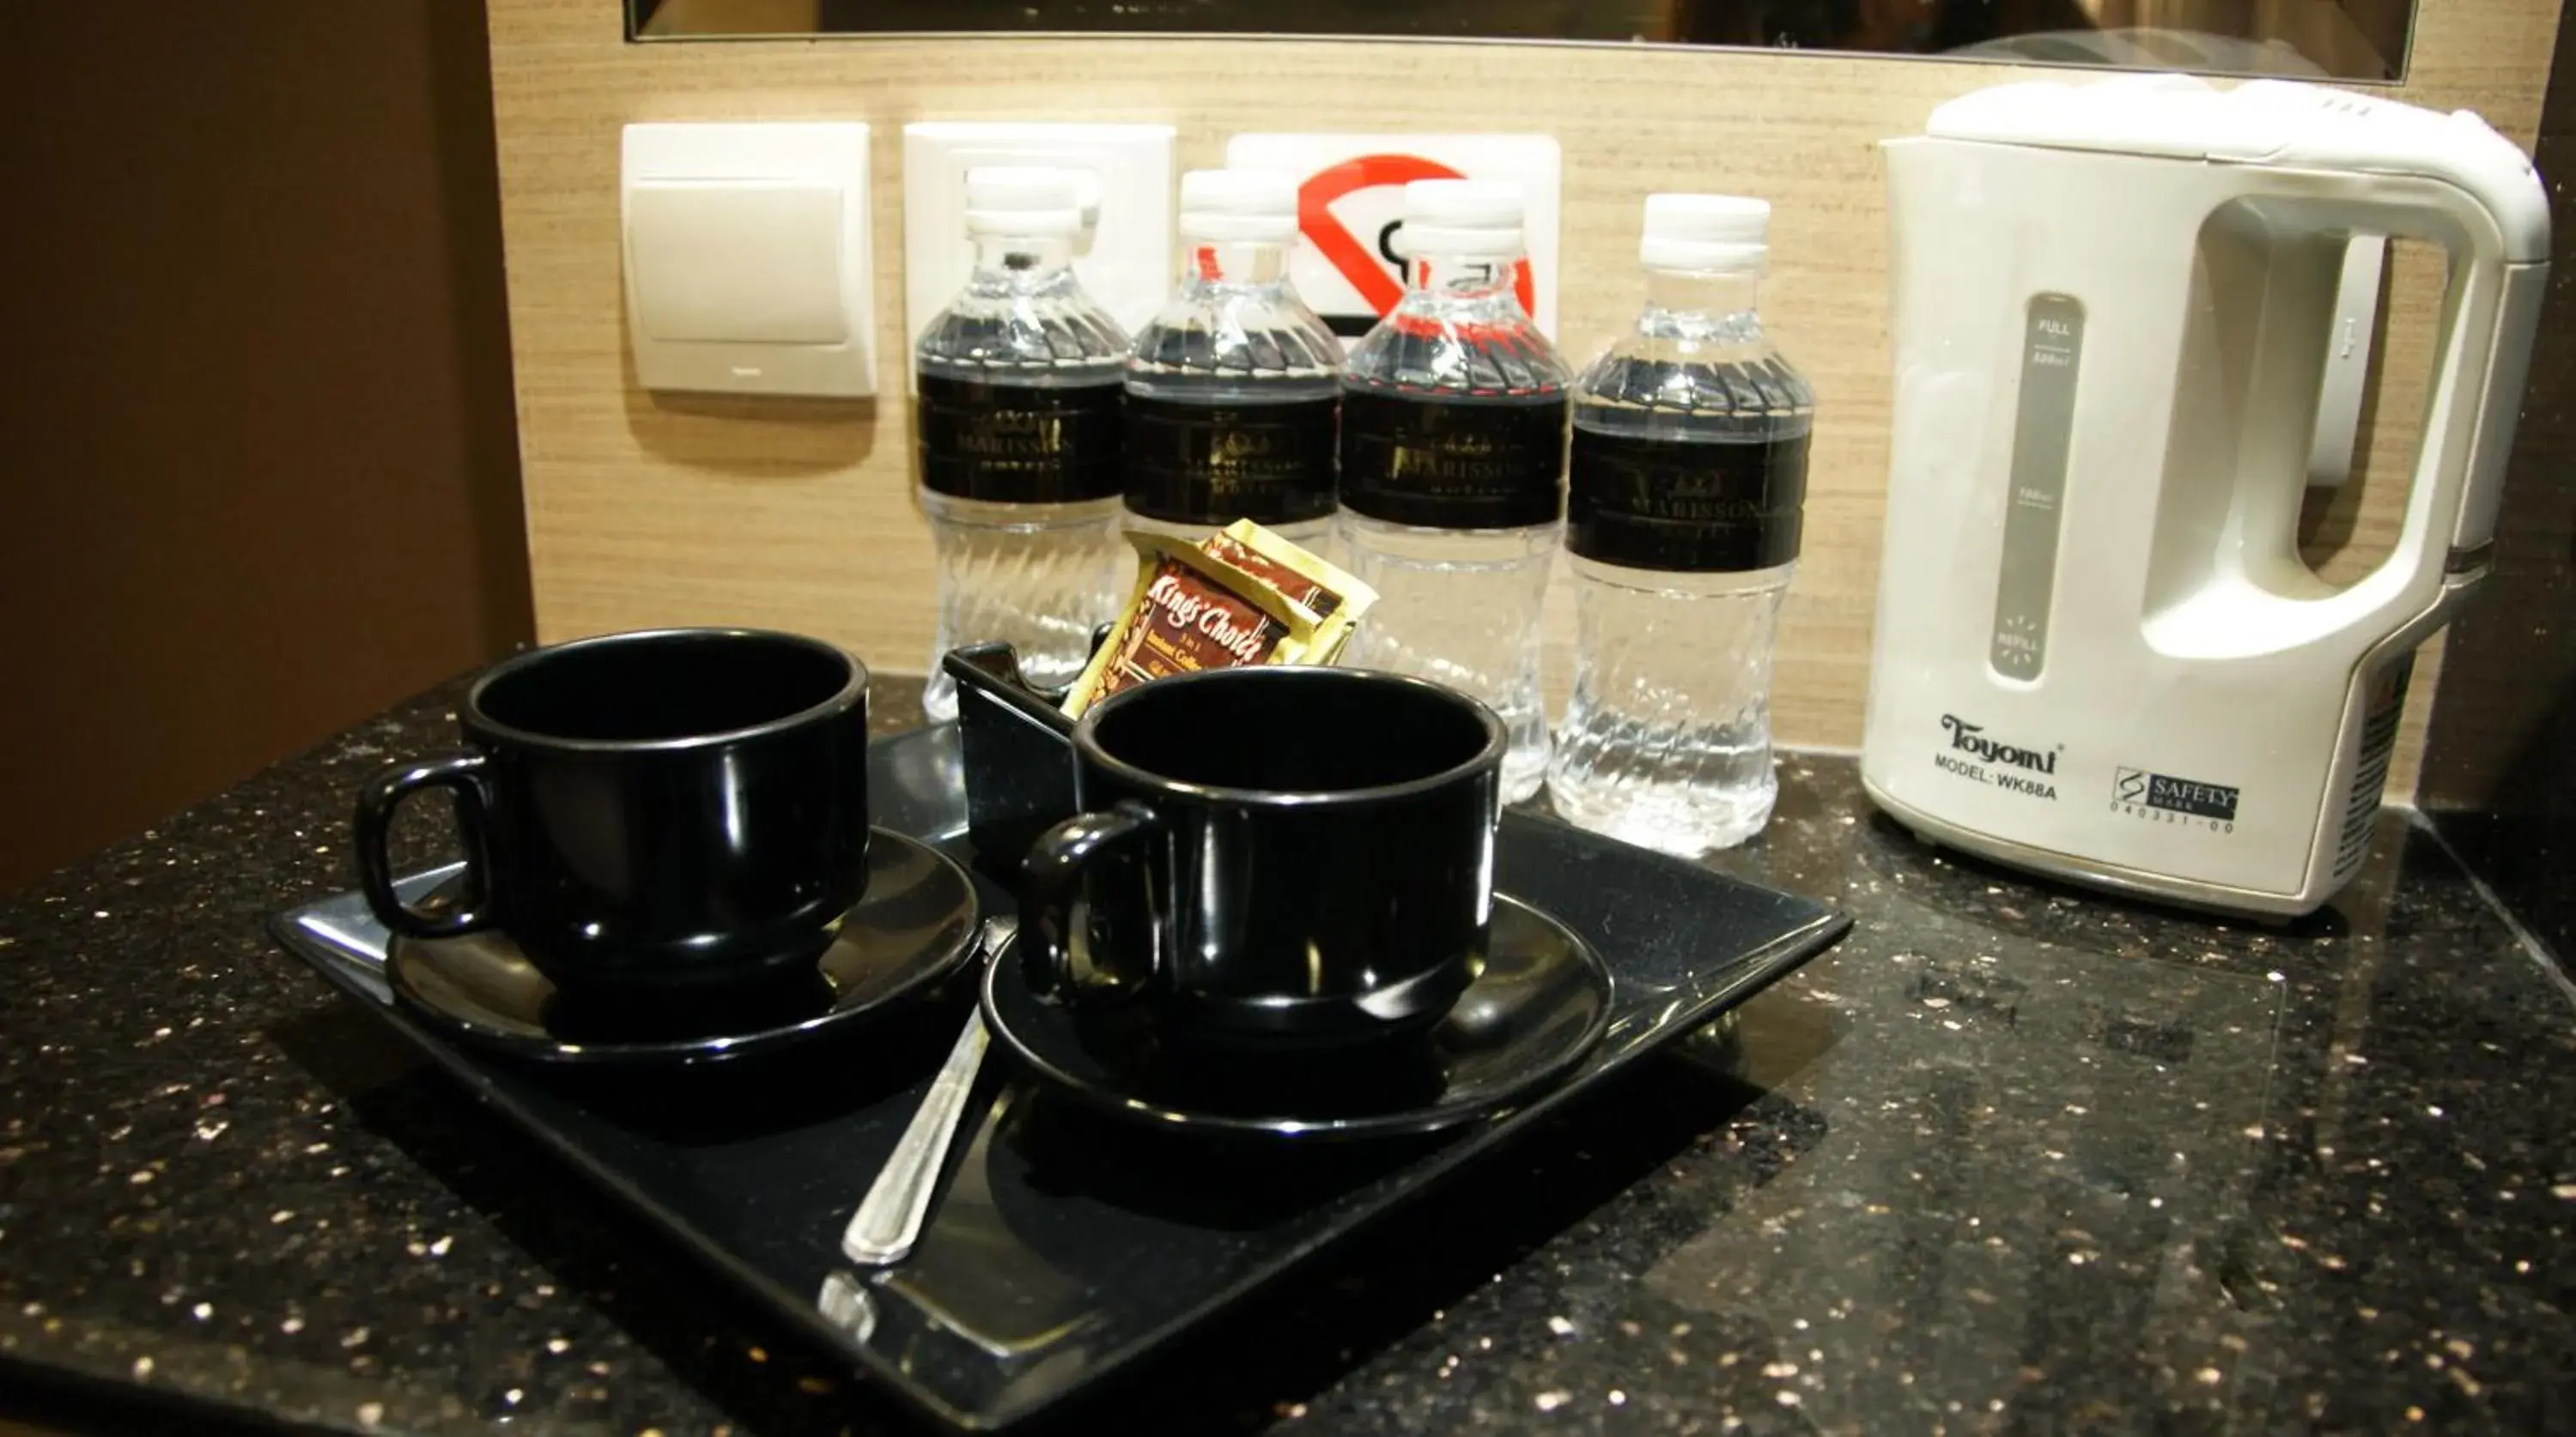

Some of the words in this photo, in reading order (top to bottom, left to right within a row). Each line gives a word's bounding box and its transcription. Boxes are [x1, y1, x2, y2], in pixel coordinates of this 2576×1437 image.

[2038, 318, 2071, 336] FULL
[1200, 608, 1263, 663] Choice
[1941, 713, 2058, 775] Toyomi
[1935, 752, 1993, 784] MODEL:
[1996, 773, 2057, 800] WK88A
[2154, 778, 2237, 808] SAFETY
